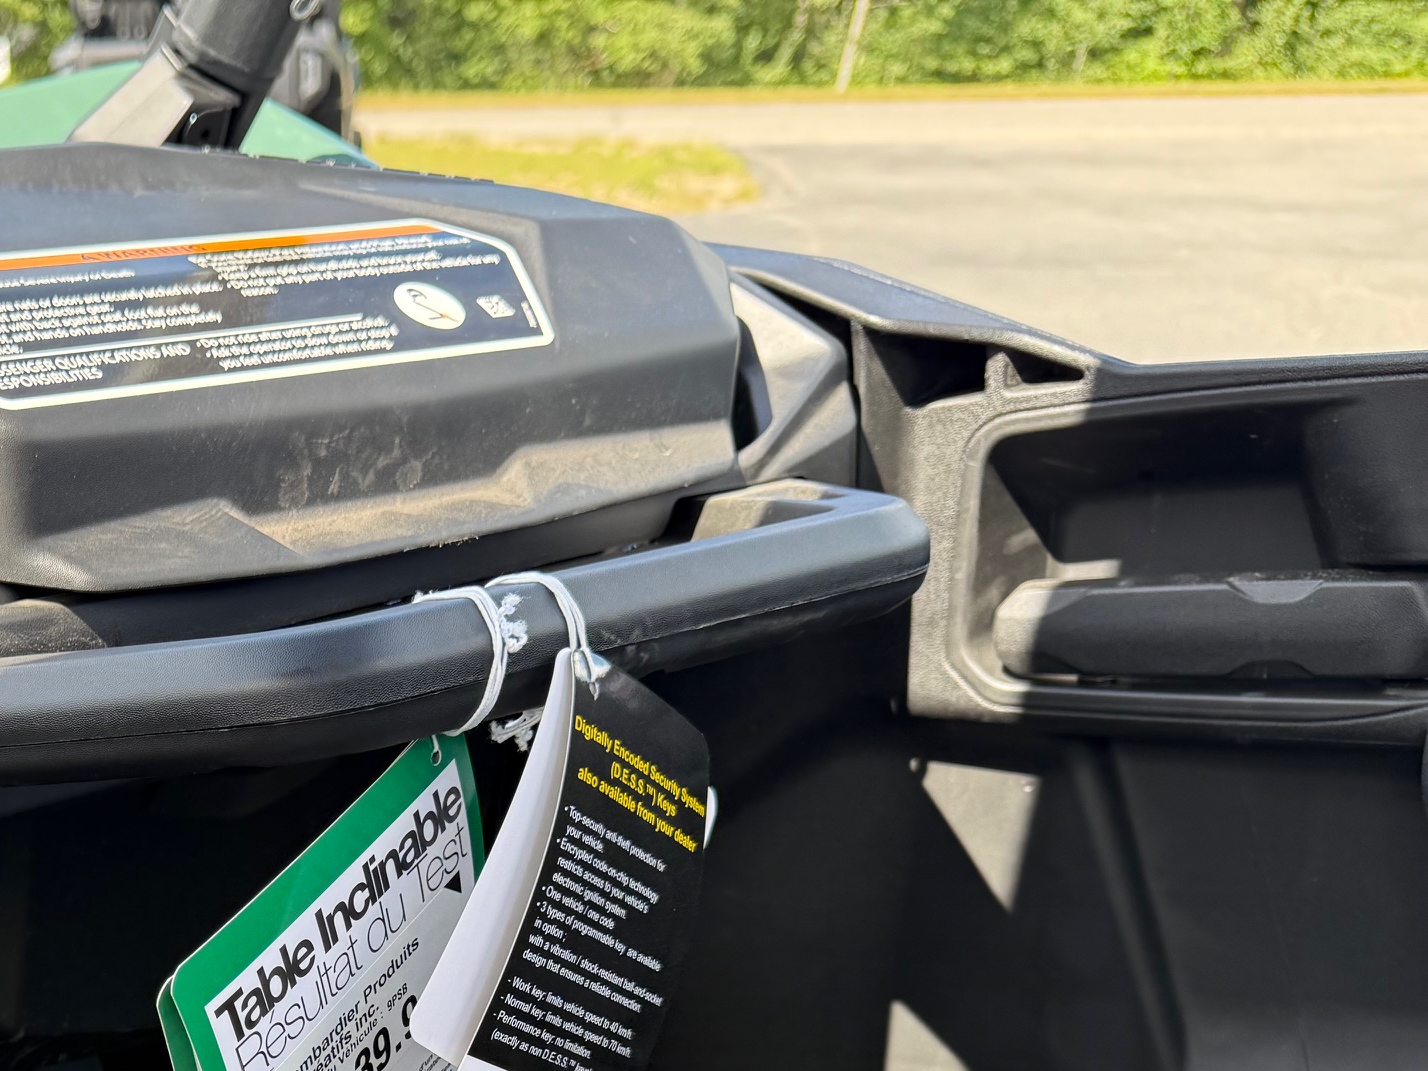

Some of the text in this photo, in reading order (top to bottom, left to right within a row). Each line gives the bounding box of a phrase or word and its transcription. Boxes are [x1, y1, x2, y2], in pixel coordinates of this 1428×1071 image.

[61, 346, 160, 373] QUALIFICATIONS
[162, 343, 190, 358] AND
[572, 713, 706, 818] Digitally Encoded Security System
[576, 764, 697, 854] also available from your dealer
[655, 792, 678, 820] Keys
[214, 786, 462, 1042] Table Inclinable
[367, 894, 407, 953] du
[407, 826, 468, 903] Test
[545, 885, 615, 930] One vehicle one code
[362, 937, 419, 1007] Produits
[338, 1019, 378, 1066] Véhicule
[386, 982, 408, 1013] 9PSB
[354, 1005, 380, 1032] inc.
